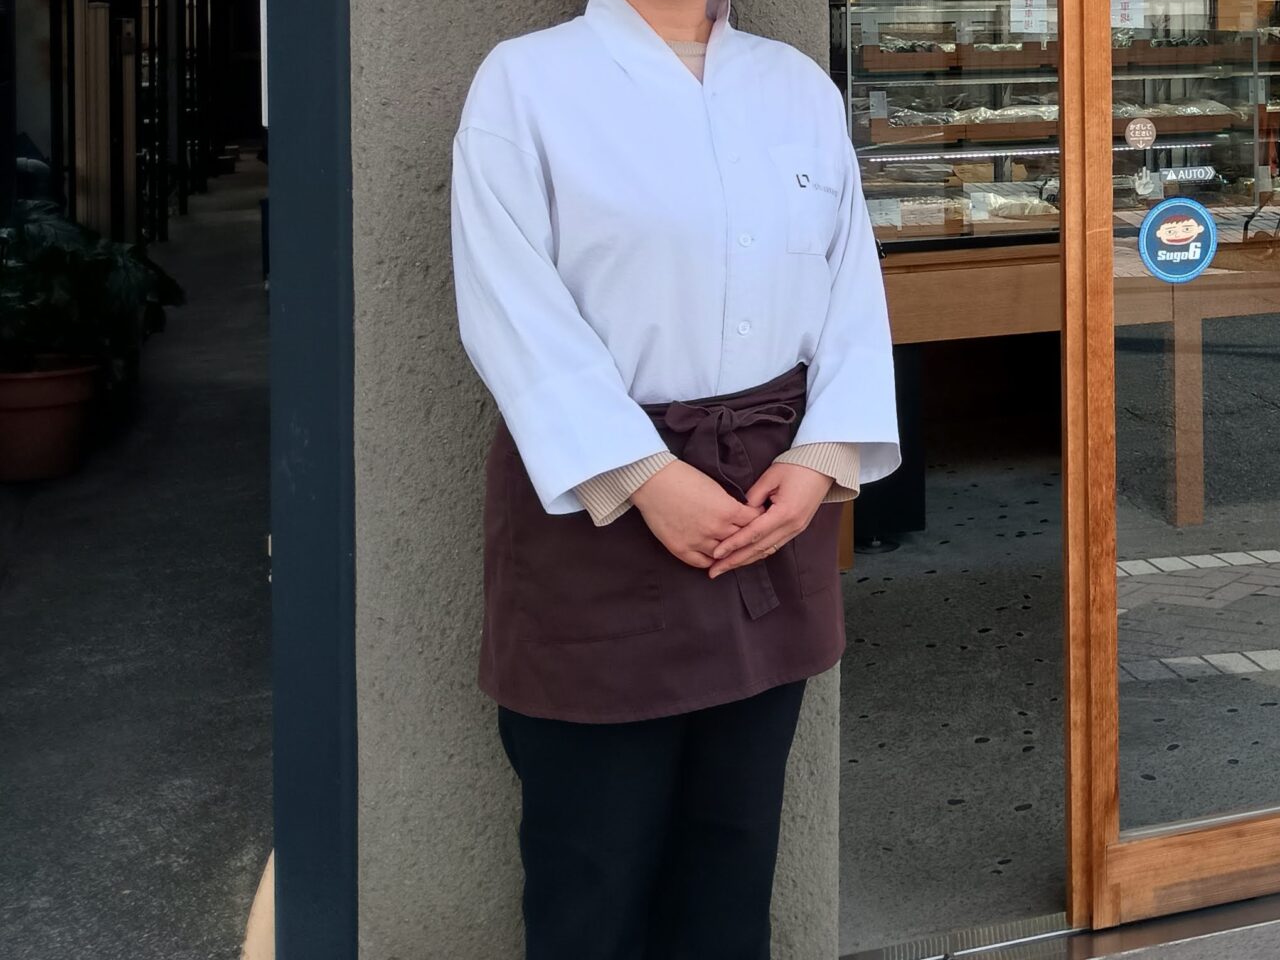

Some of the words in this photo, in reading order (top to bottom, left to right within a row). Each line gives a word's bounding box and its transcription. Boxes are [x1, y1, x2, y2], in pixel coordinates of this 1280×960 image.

[1129, 123, 1152, 131] かざして
[1178, 169, 1205, 180] AUTO
[1157, 242, 1202, 263] Sugo6
